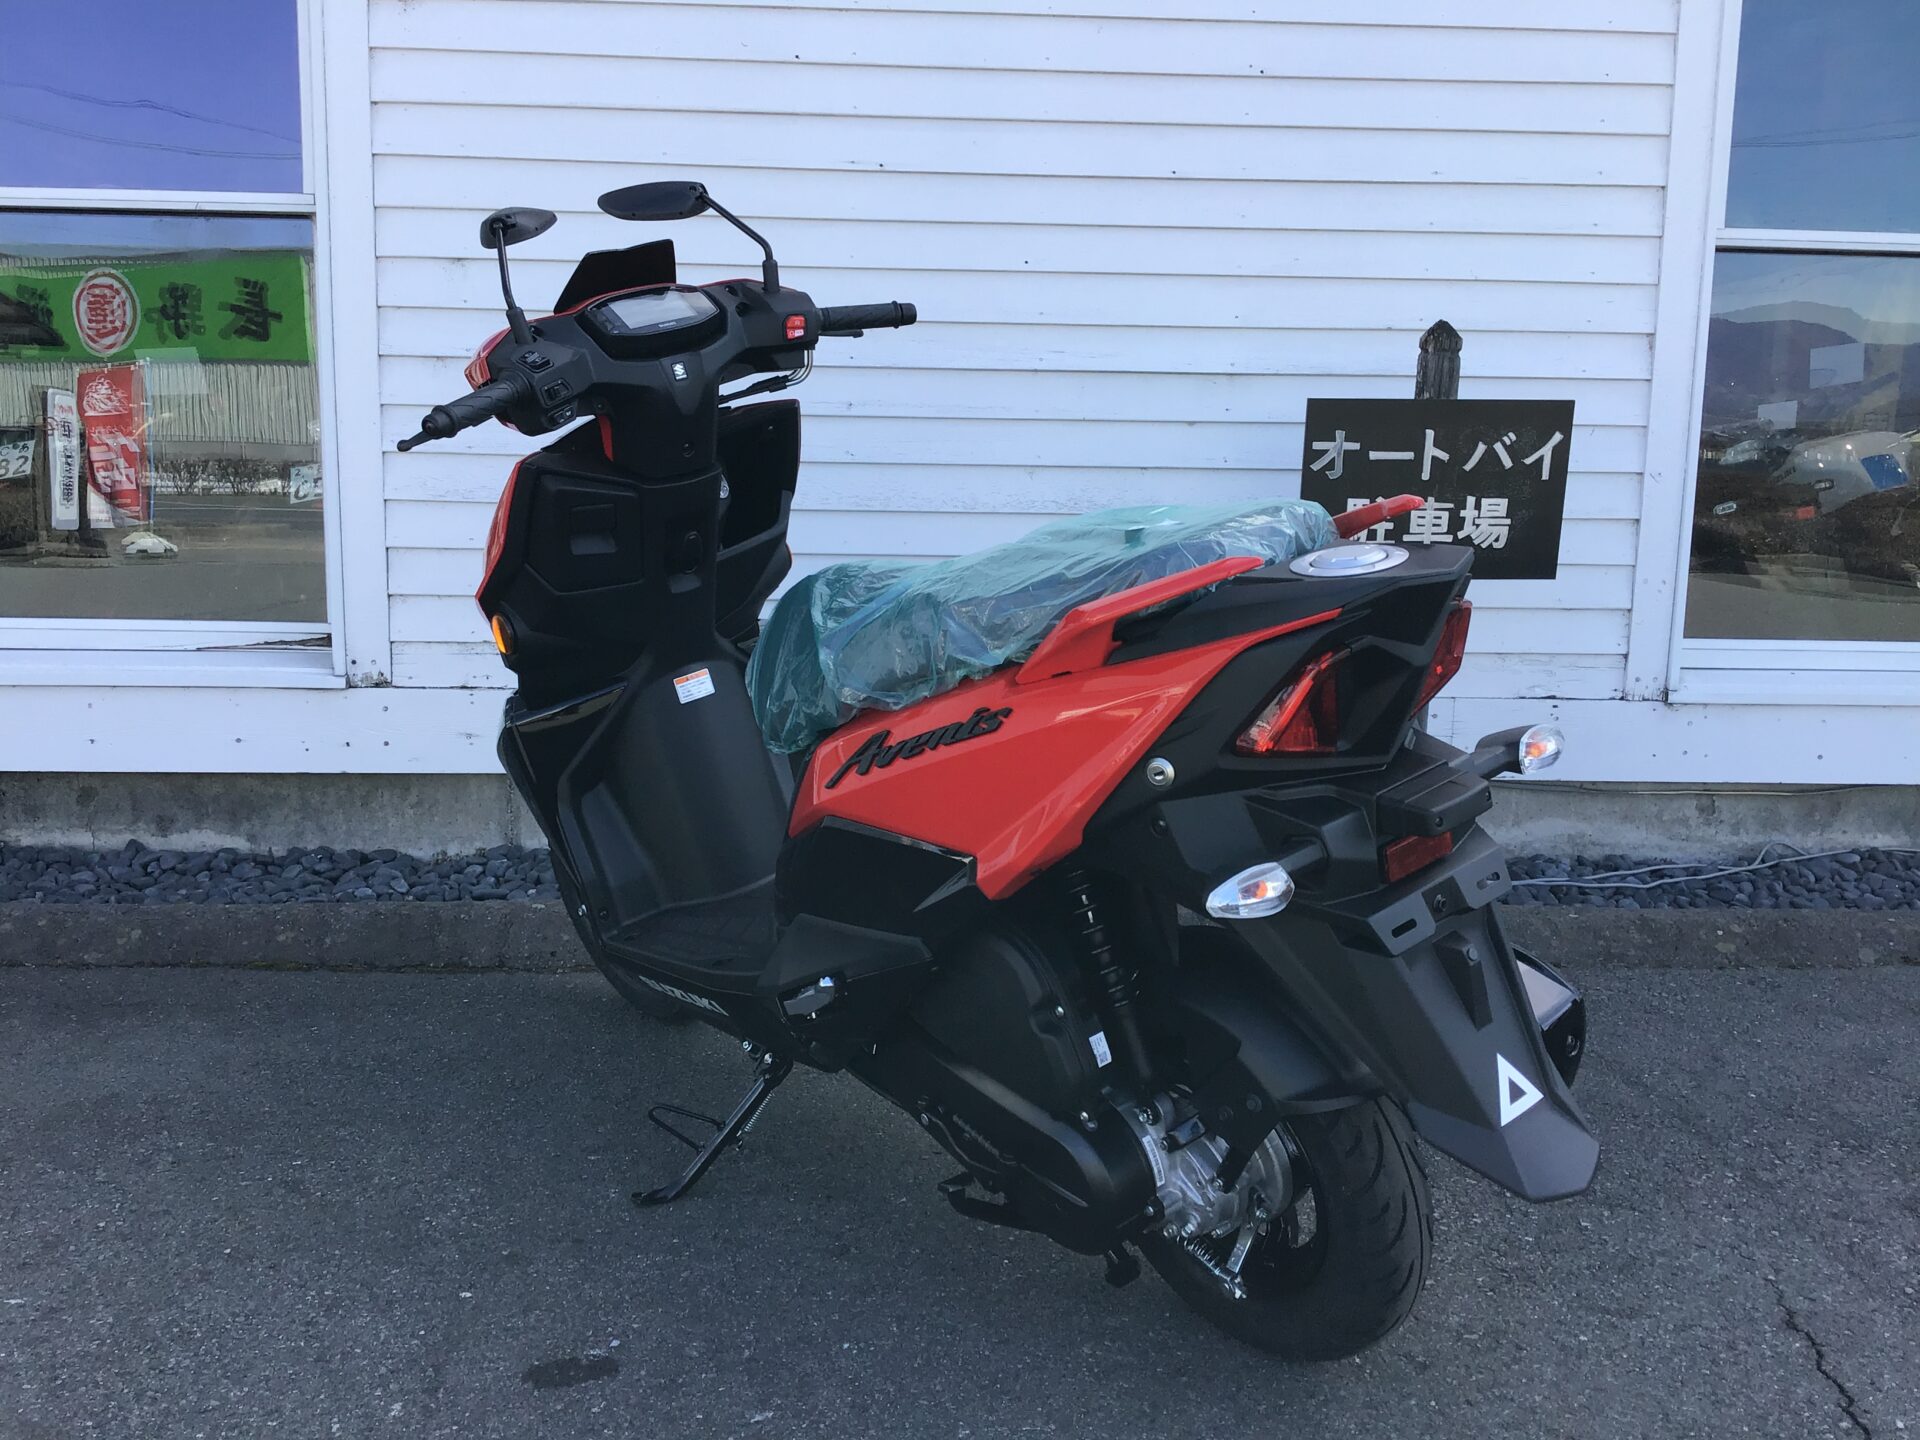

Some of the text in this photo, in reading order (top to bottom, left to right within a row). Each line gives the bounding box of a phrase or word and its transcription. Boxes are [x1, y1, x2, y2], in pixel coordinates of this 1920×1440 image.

[1309, 429, 1564, 480] オートバイ
[825, 707, 1014, 789] Avenis
[638, 975, 729, 1017] SUZUKI
